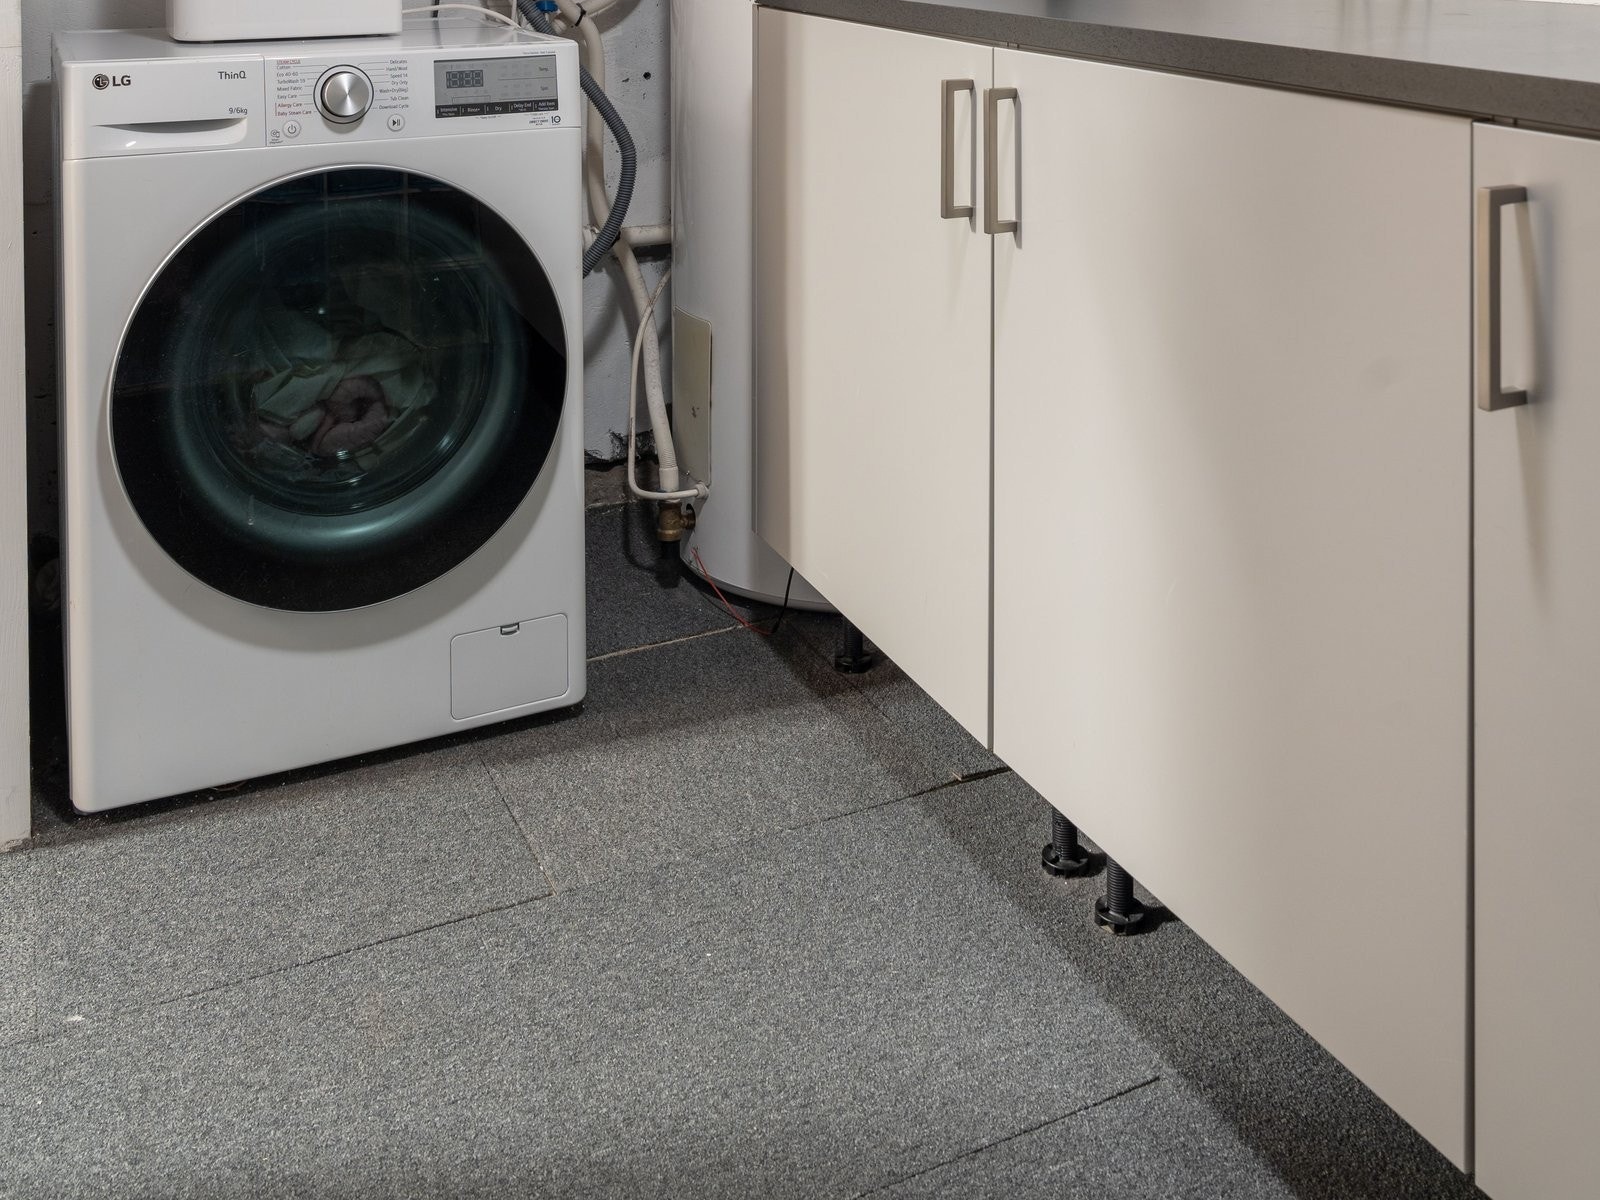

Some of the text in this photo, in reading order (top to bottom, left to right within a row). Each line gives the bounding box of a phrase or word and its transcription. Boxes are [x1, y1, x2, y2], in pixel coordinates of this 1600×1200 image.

[217, 70, 247, 80] ThinQ
[112, 75, 131, 87] LG
[228, 107, 248, 115] 9/6kg
